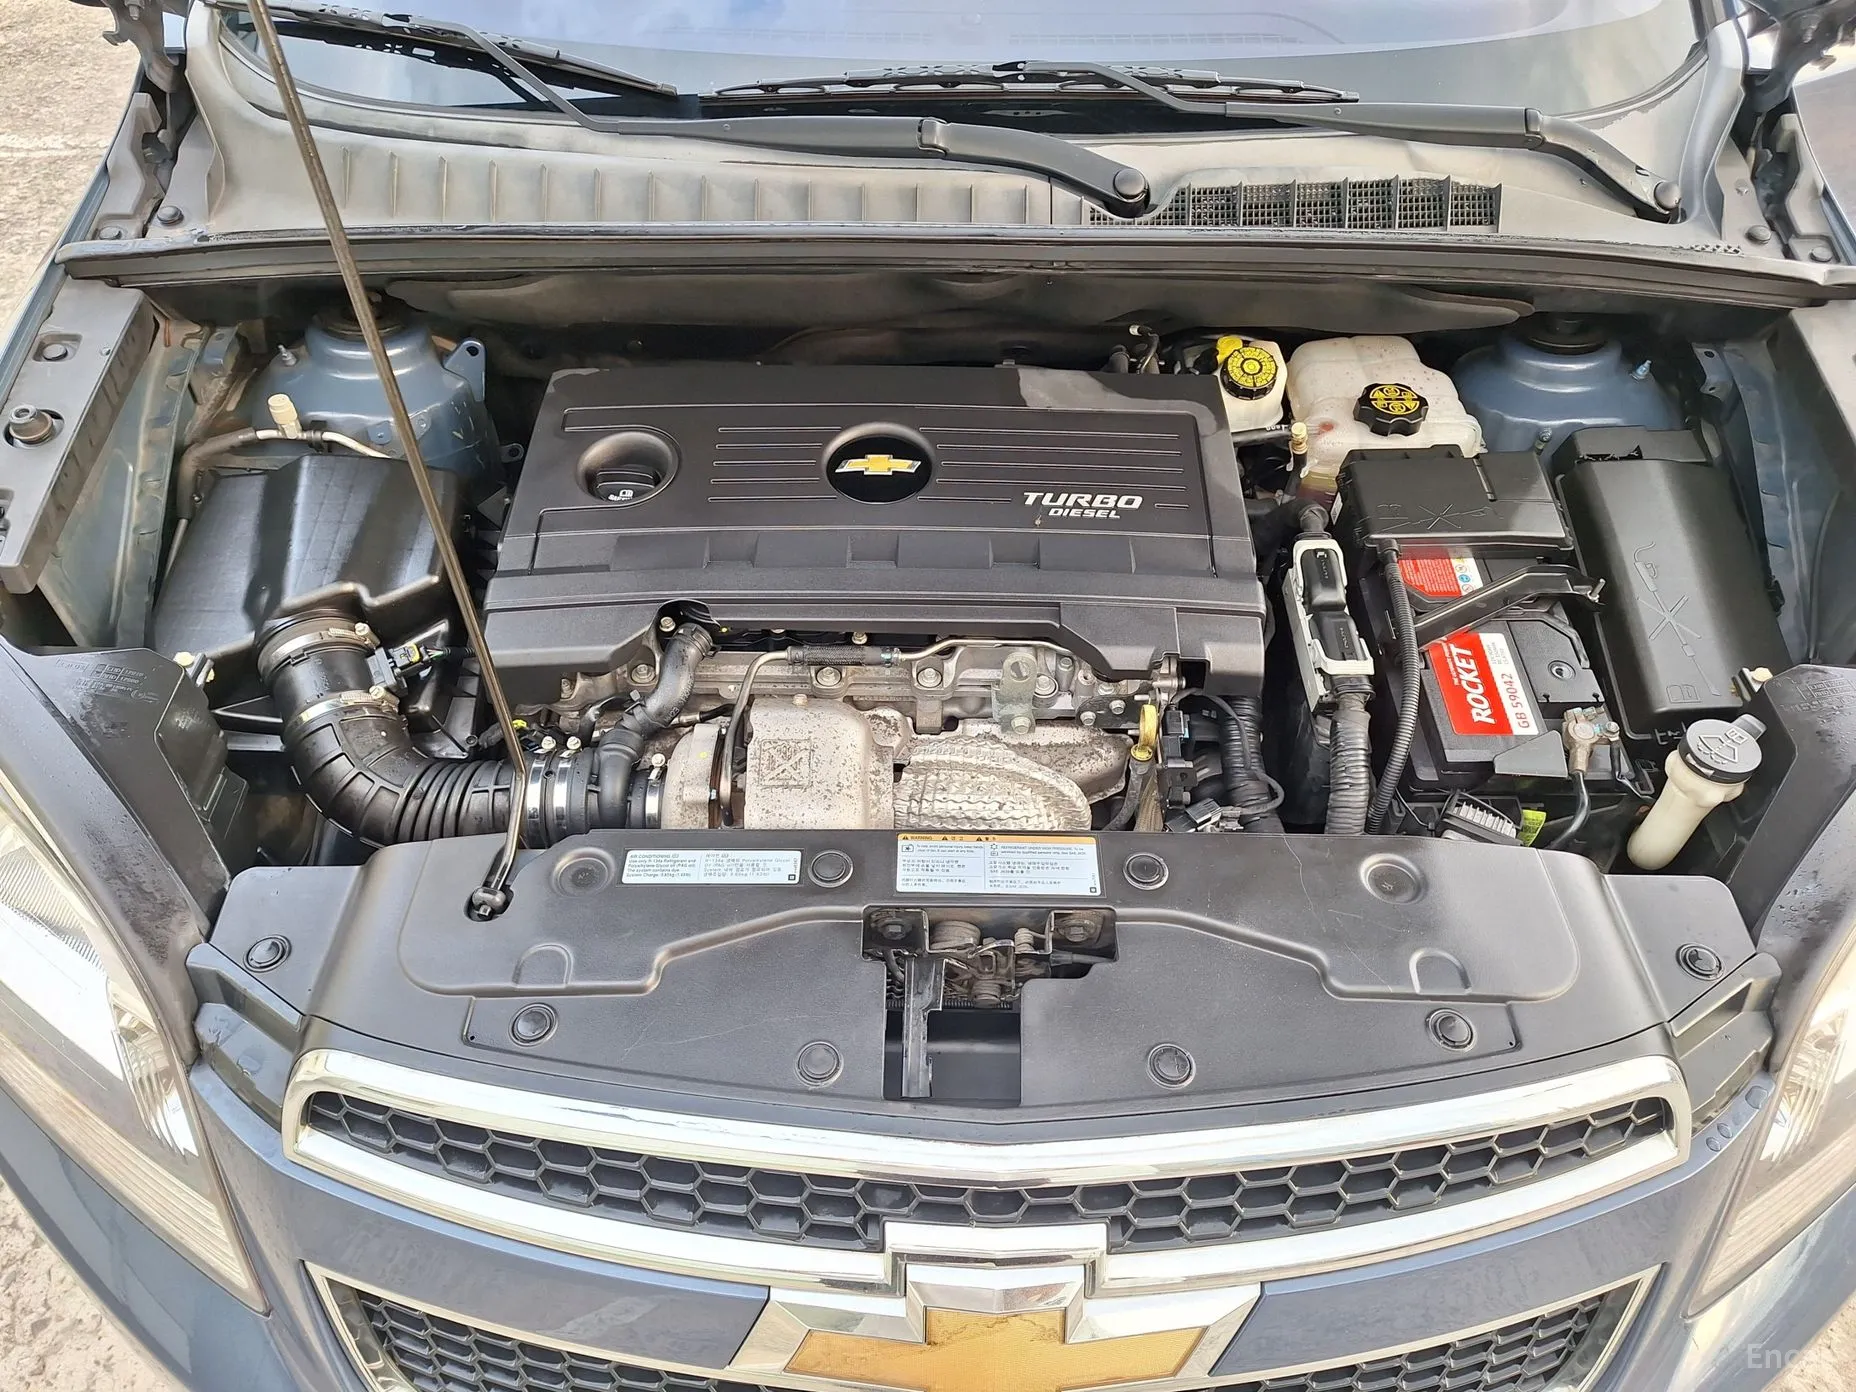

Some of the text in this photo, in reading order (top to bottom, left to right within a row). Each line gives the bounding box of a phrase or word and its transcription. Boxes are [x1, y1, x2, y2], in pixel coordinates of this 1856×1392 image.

[1023, 491, 1143, 509] TURBO
[1048, 507, 1121, 519] DIESEL
[1449, 643, 1497, 725] ROCKET
[1501, 673, 1530, 729] GB 59042
